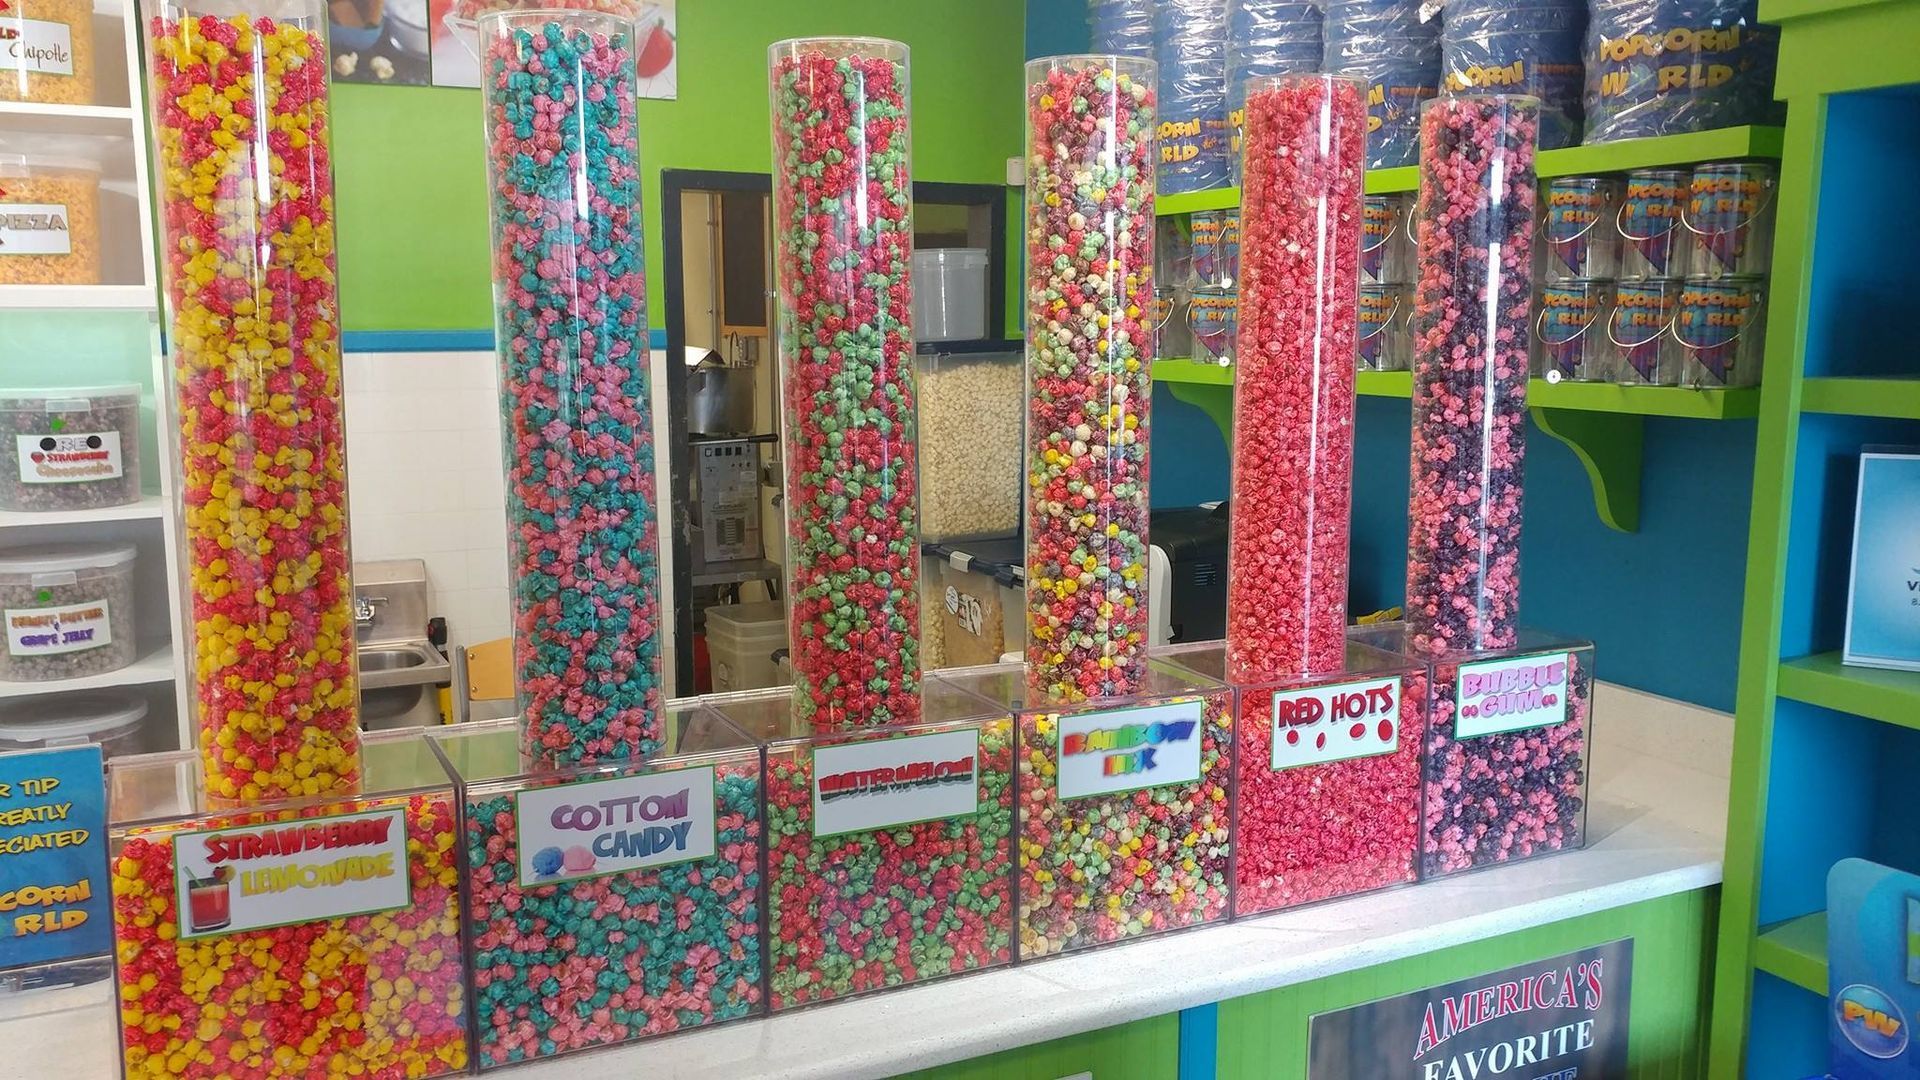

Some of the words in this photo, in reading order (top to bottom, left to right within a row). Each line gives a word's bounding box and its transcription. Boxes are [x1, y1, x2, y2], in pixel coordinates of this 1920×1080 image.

[9, 40, 69, 69] Chipotle
[1462, 662, 1565, 699] BUBBLE
[1278, 697, 1325, 729] RED
[1330, 683, 1394, 724] HOTS
[1480, 689, 1543, 718] GUM
[19, 777, 60, 796] TIP
[818, 756, 974, 803] WATERMELON
[0, 803, 72, 826] REATLY
[550, 788, 690, 831] COTTON
[204, 816, 394, 864] STRAWBERRY
[592, 821, 693, 858] CANDY
[240, 852, 395, 897] LEMONADE
[1414, 958, 1604, 1061] AMERICA'S
[1842, 1000, 1902, 1038] PW
[1422, 1019, 1596, 1080] FAVORITE
